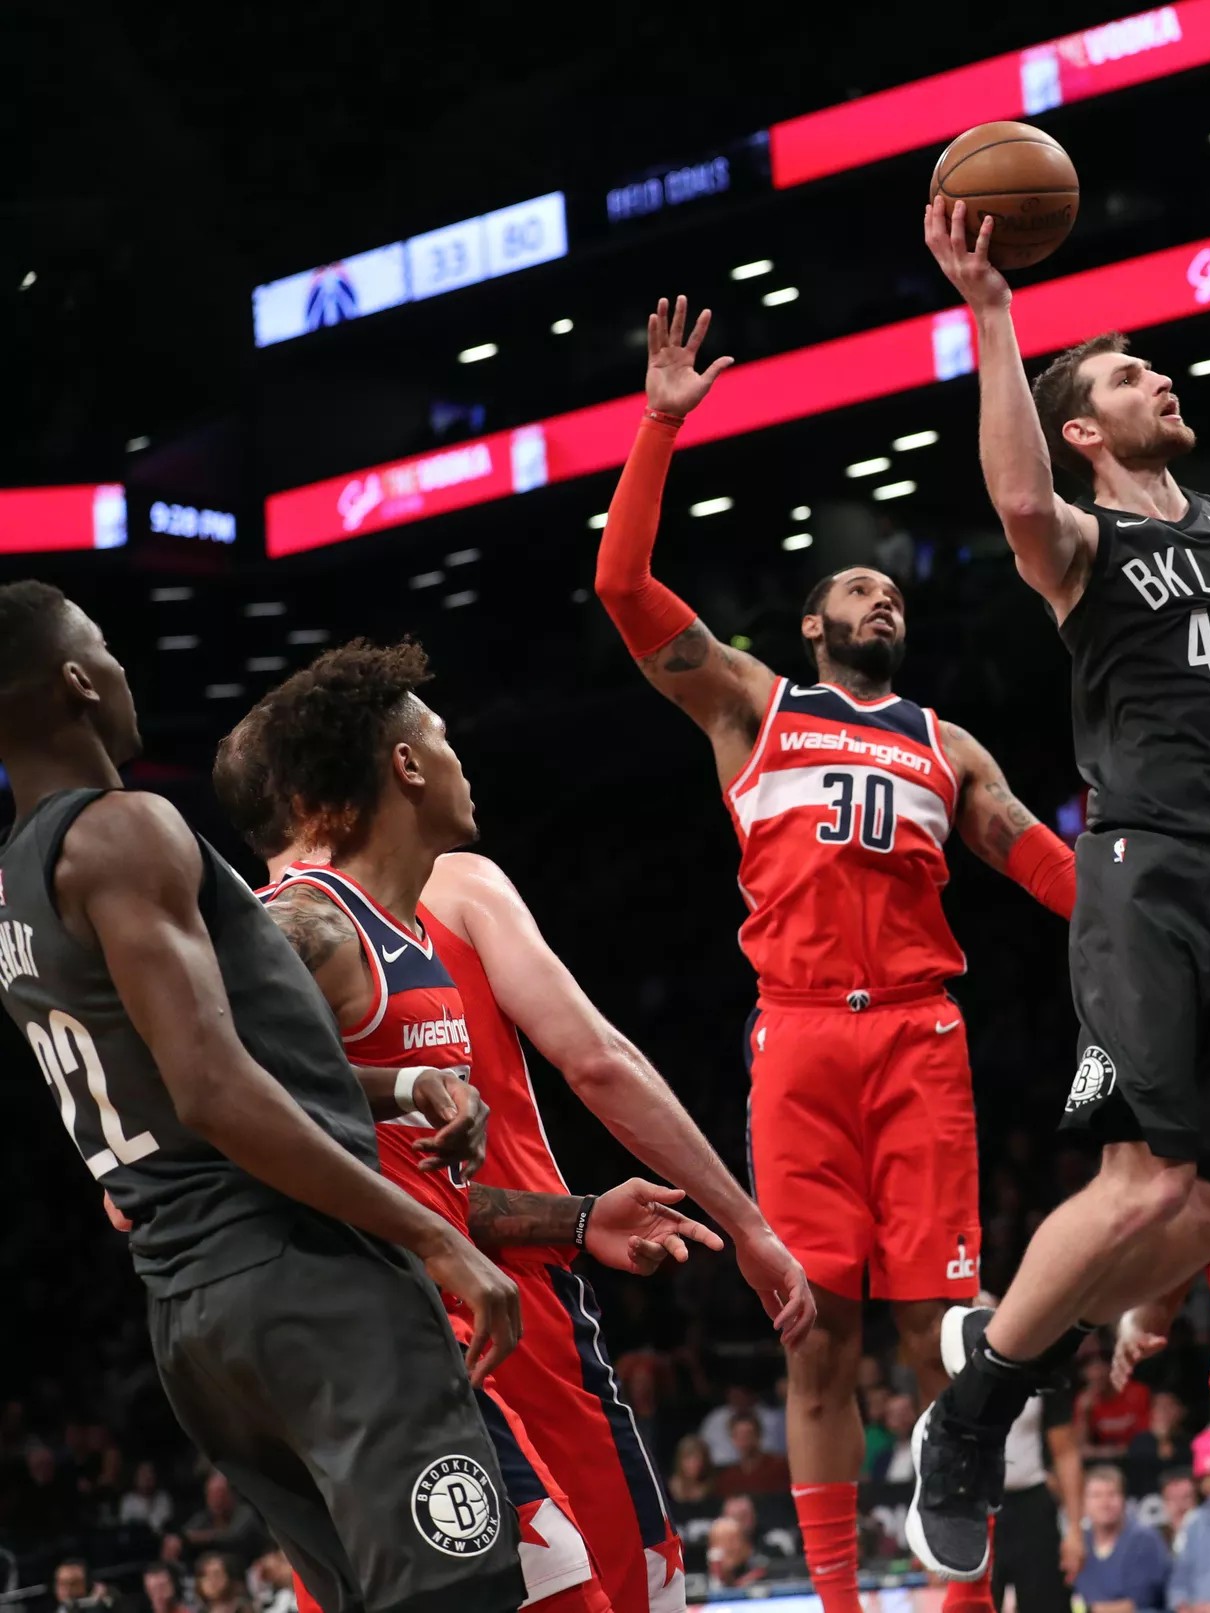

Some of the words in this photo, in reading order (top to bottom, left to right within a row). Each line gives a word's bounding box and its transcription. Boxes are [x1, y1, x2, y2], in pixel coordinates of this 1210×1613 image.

[780, 729, 932, 775] washington
[816, 771, 895, 854] 30
[26, 1009, 160, 1181] 22
[575, 1212, 587, 1244] Believe
[417, 1460, 488, 1502] BROOKLYN
[447, 1482, 476, 1531] B
[432, 1531, 466, 1552] NEW
[473, 1517, 498, 1549] YORK
